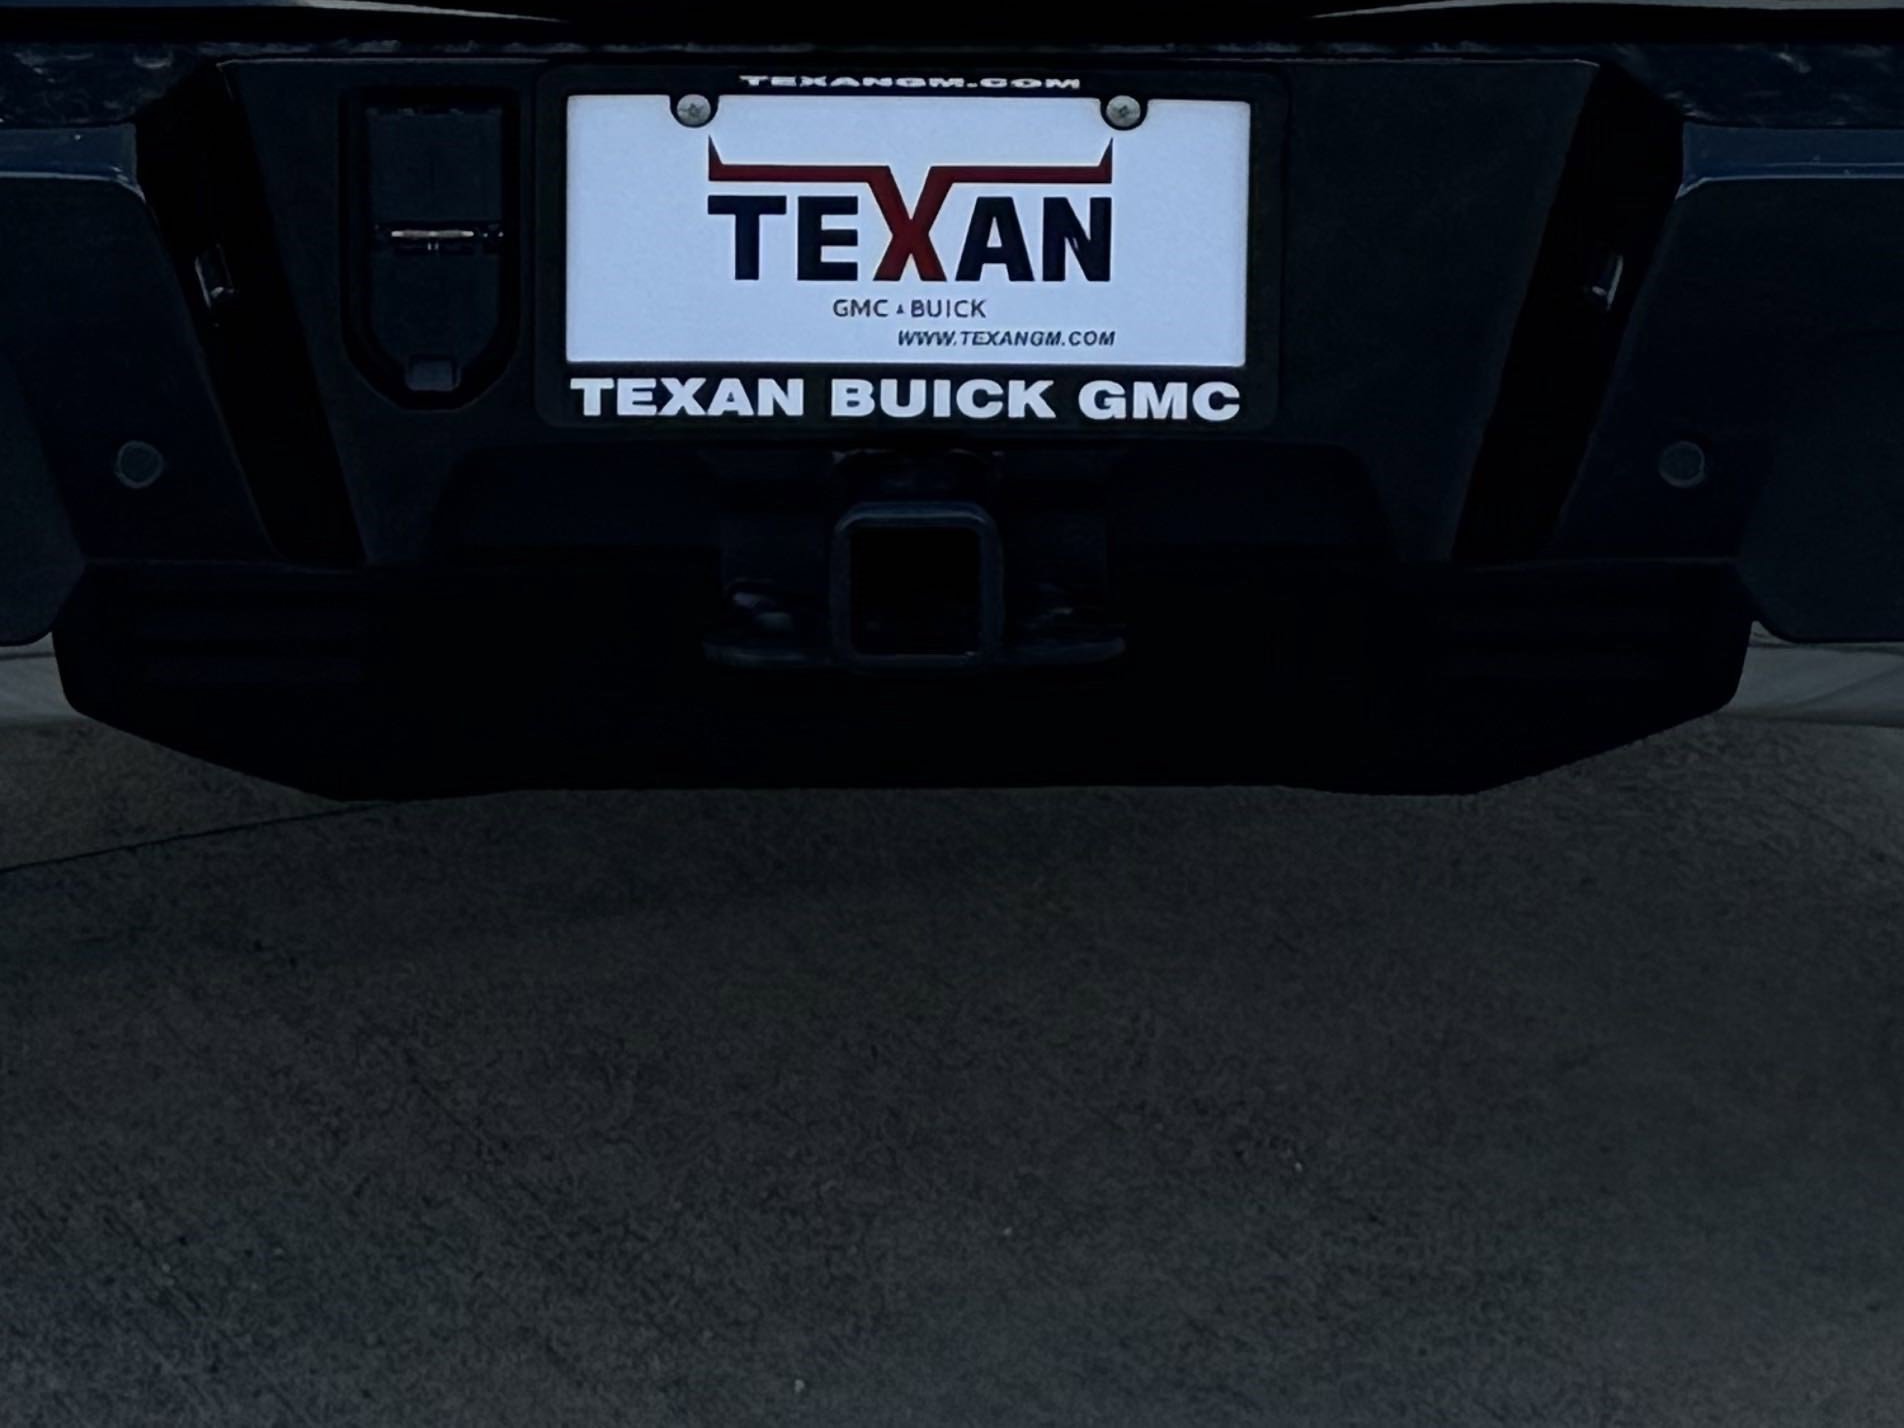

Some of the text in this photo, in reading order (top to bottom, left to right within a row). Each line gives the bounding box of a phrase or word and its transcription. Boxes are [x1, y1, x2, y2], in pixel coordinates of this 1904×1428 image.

[739, 74, 1081, 89] TEXANGM.COM
[707, 164, 1114, 283] TEXAN
[832, 298, 988, 319] GMC BUICK
[897, 330, 1117, 347] WWW.TEXANGM.COM
[570, 377, 1241, 422] TEXAN BUICK GMC
